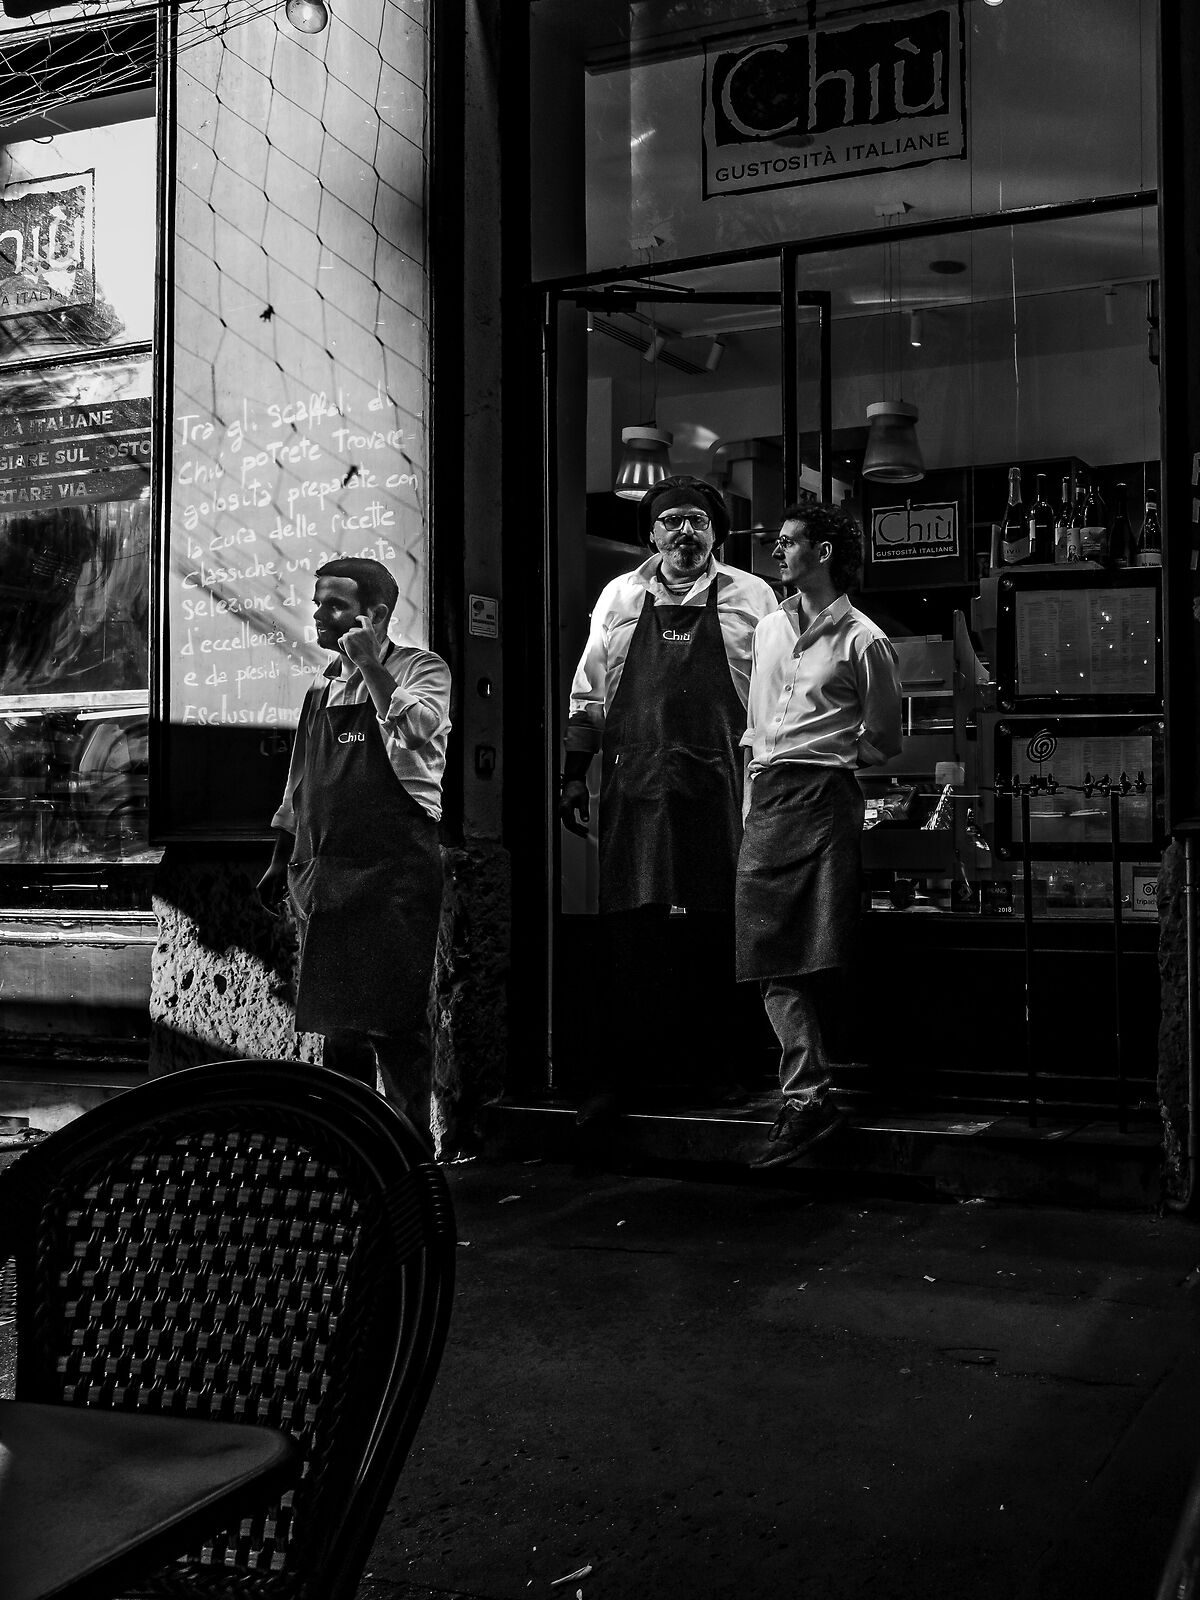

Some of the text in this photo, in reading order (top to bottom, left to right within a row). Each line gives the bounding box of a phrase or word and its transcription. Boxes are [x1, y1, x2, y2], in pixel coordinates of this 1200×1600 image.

[721, 0, 944, 137] Chiù
[715, 131, 949, 182] GUSTOSITÀ ITALIANE
[29, 409, 114, 433] ITALIANE
[176, 414, 215, 446] Tra
[227, 397, 258, 453] gli
[367, 379, 394, 412] di
[54, 447, 90, 465] SUL
[96, 439, 151, 460] POSTO
[58, 481, 88, 498] VIA
[386, 472, 418, 491] con
[187, 500, 396, 560] la cura delle ricette
[878, 498, 952, 543] Chiù
[876, 545, 954, 558] GUSTOSITÀ ITALIANE
[662, 629, 691, 641] Chiù
[183, 670, 200, 687] e
[205, 663, 228, 687] da
[337, 731, 366, 744] Chiù
